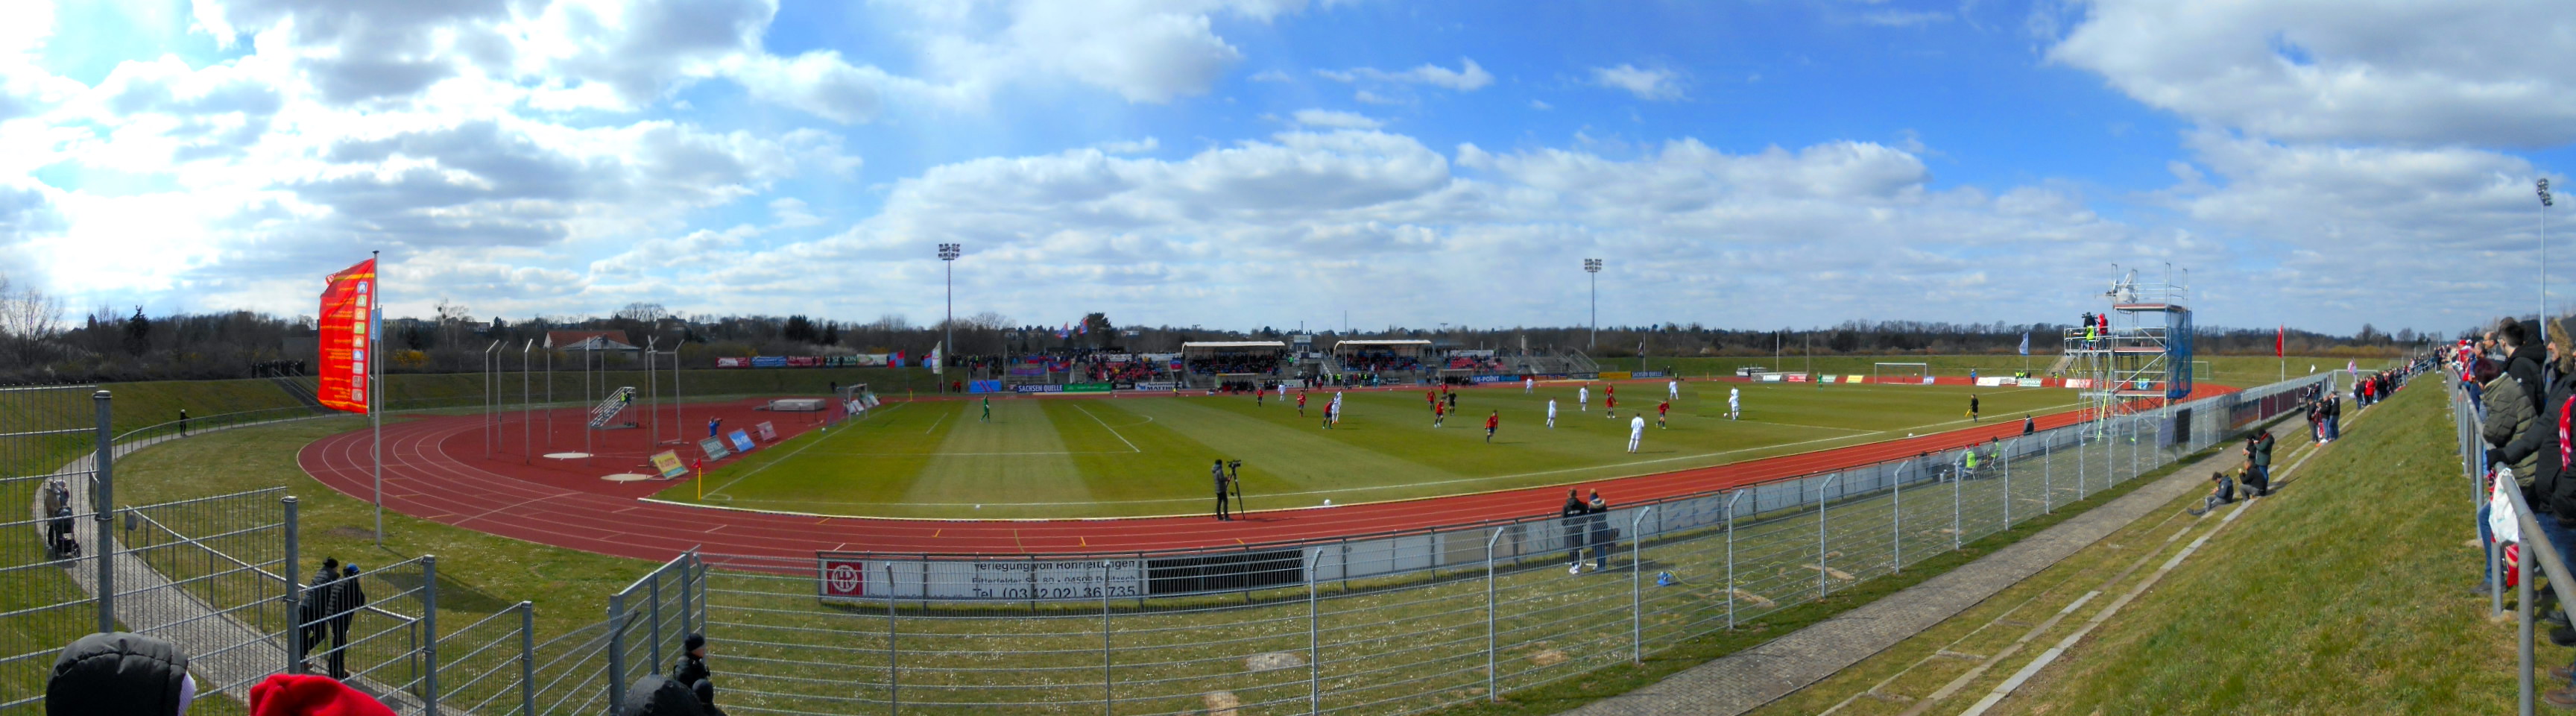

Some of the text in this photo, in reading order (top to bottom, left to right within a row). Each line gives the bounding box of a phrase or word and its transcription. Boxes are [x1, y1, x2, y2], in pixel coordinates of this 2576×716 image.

[1018, 384, 1042, 392] SACHSEN
[1044, 383, 1063, 392] QUELLE
[975, 562, 1030, 572] Verlegung
[1056, 560, 1135, 570] Rohrleitungen
[1096, 574, 1136, 583] Deitzsch
[1052, 586, 1077, 598] 02)
[1083, 586, 1102, 597] 36
[1108, 585, 1136, 597] 735
